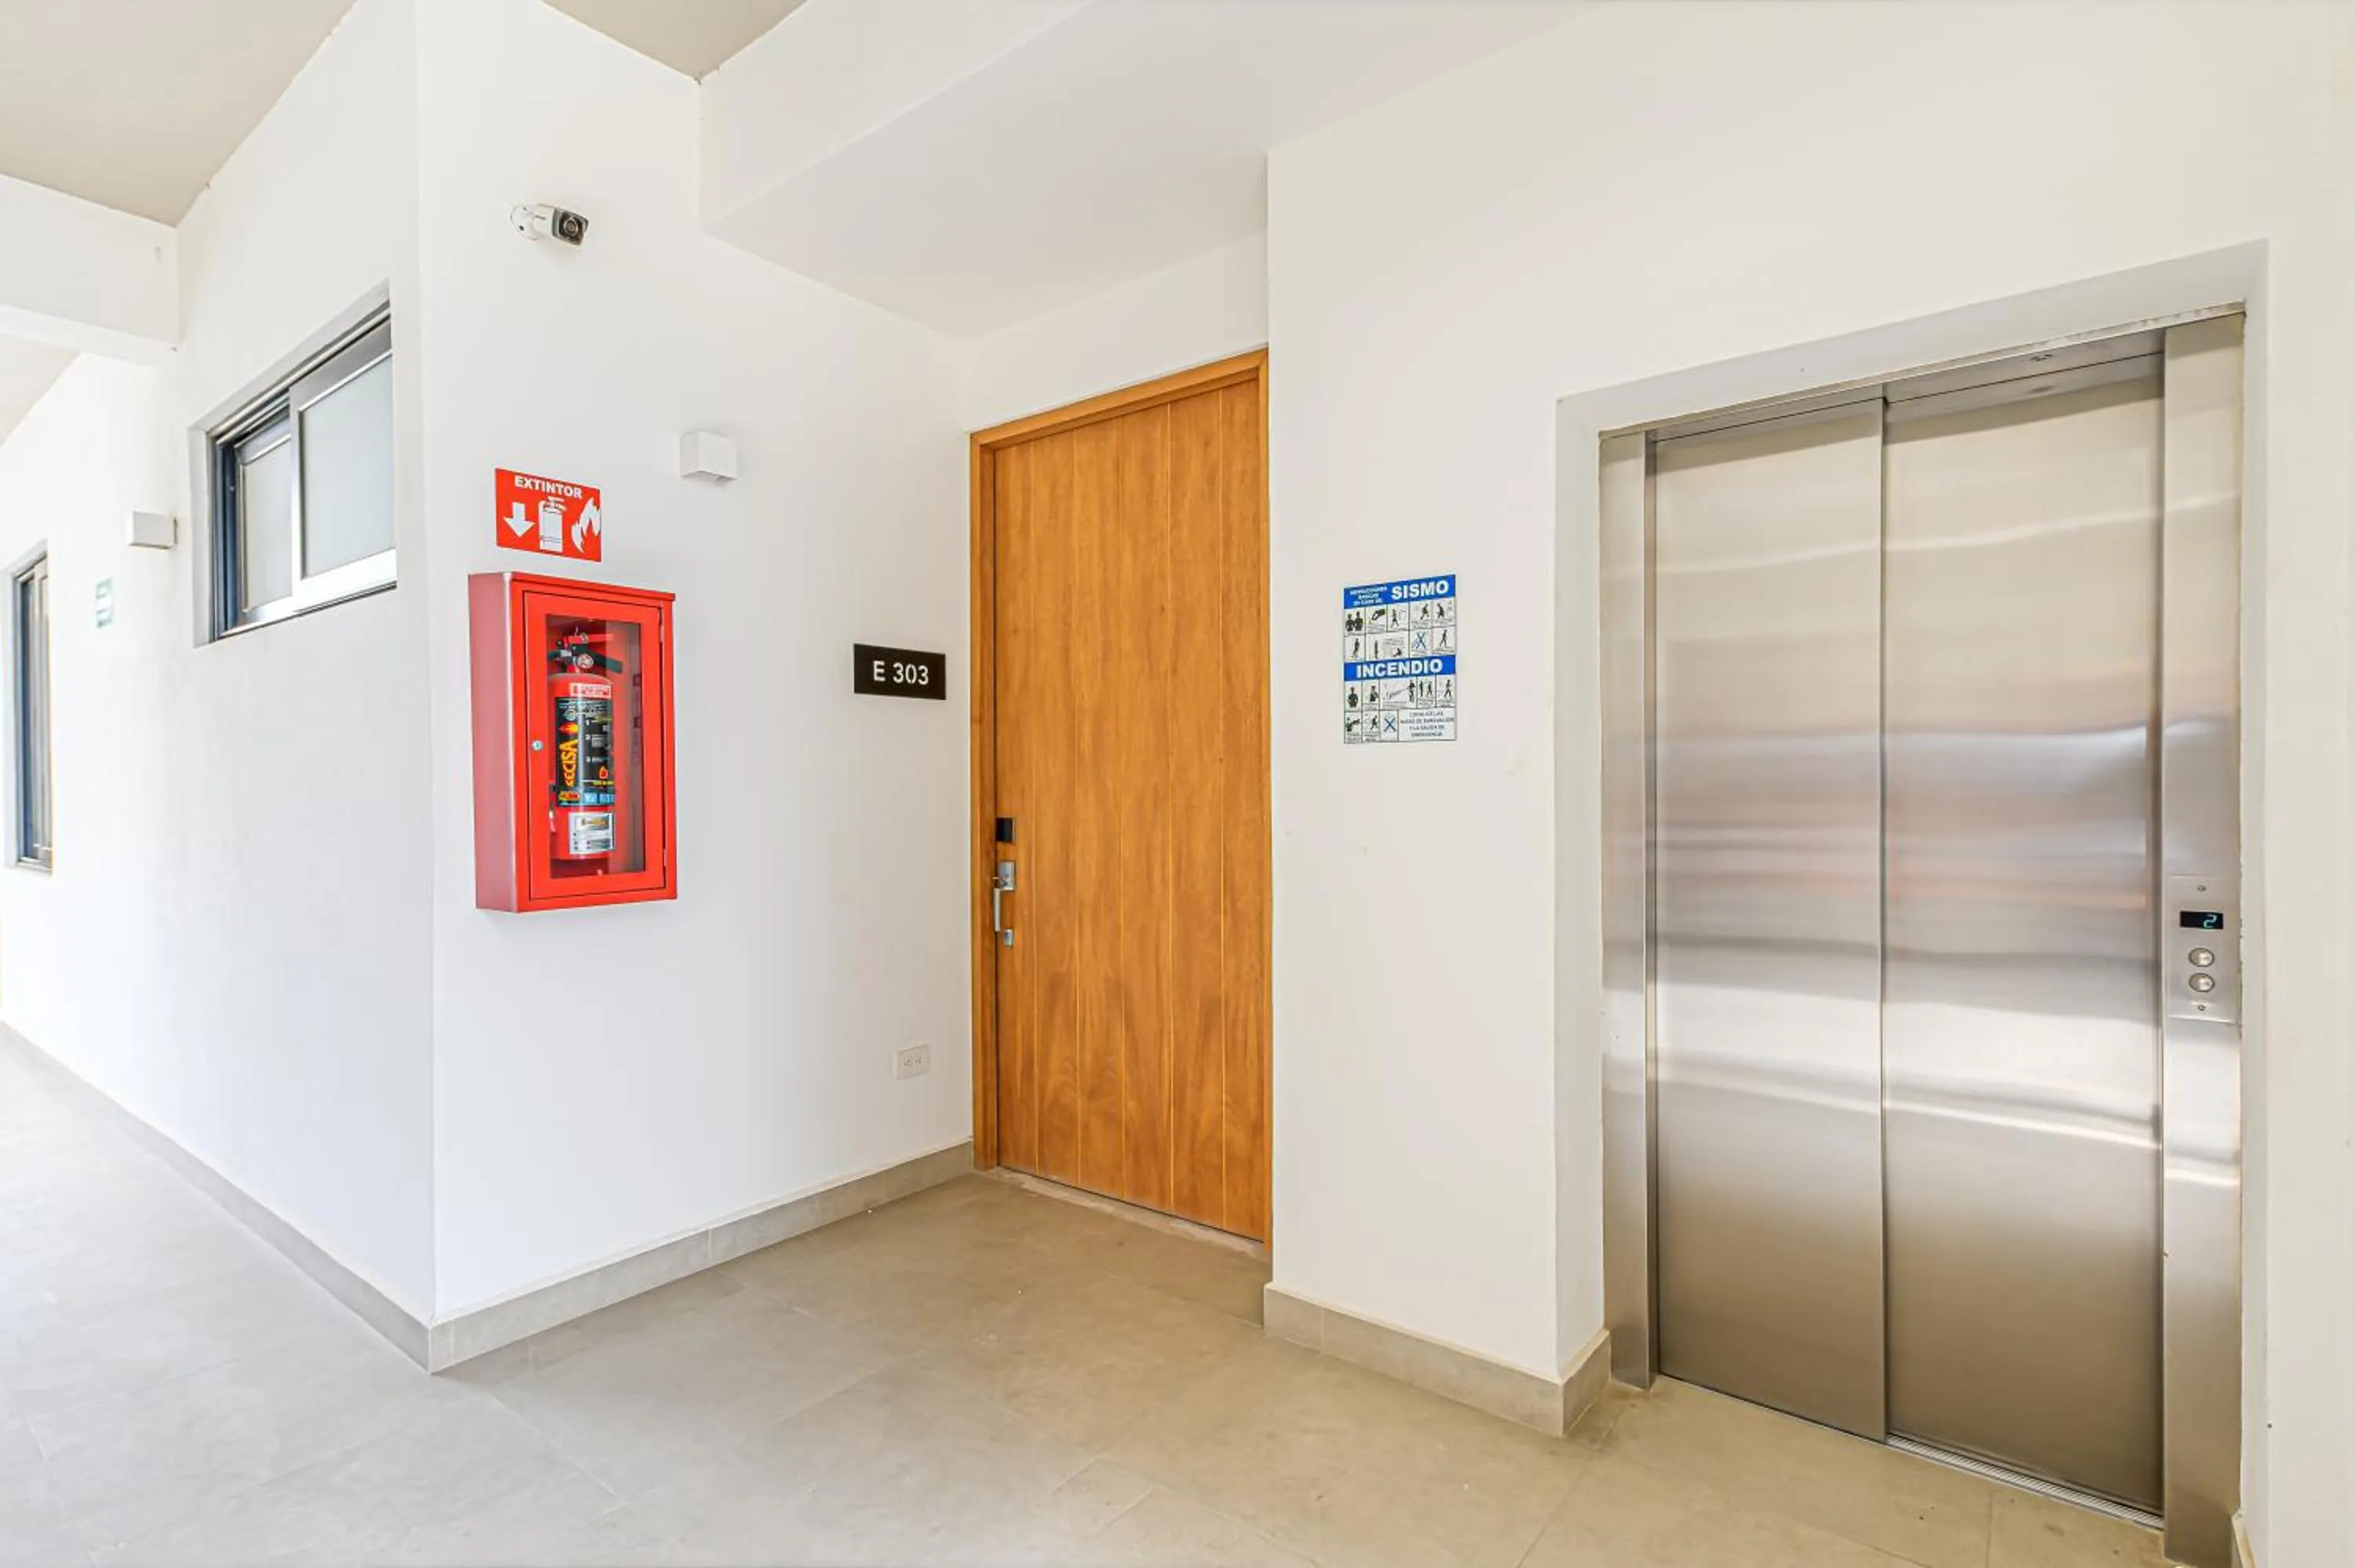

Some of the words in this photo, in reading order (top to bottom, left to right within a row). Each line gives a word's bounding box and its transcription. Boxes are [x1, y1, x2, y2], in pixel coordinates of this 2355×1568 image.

[514, 475, 582, 499] EXTINTOR
[1391, 580, 1449, 600] SISMO
[874, 661, 885, 681] E
[893, 662, 929, 685] 303
[1356, 658, 1443, 678] INCENDIO
[2203, 914, 2217, 928] 2
